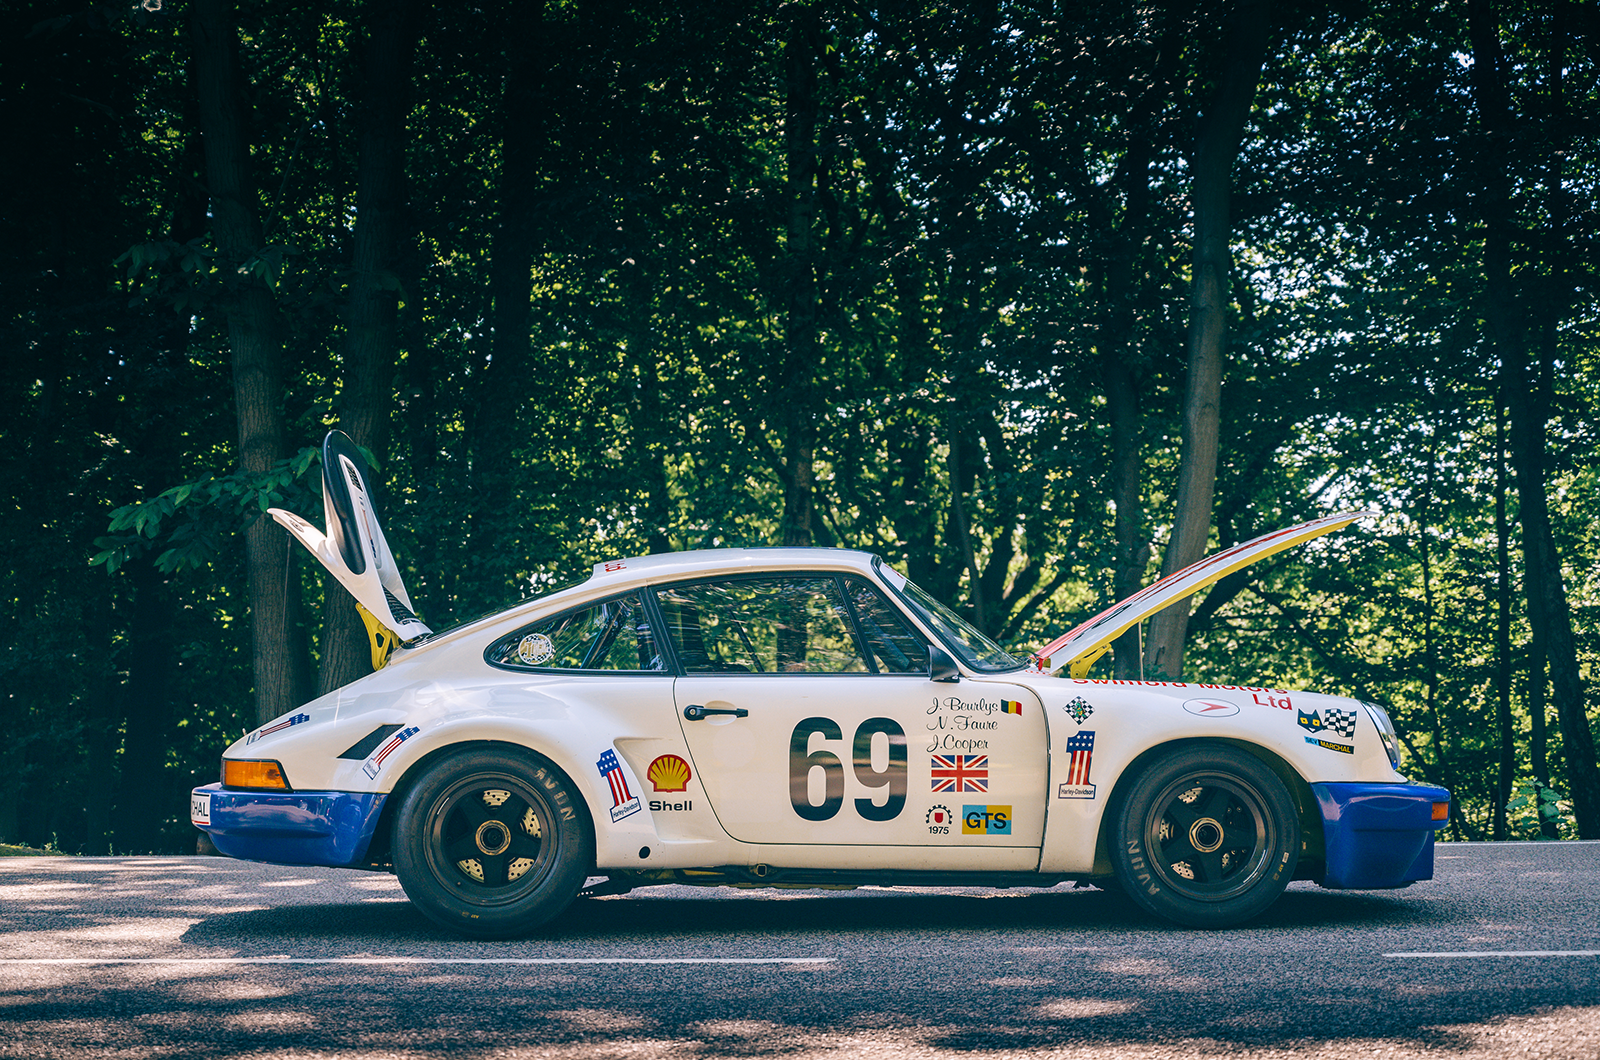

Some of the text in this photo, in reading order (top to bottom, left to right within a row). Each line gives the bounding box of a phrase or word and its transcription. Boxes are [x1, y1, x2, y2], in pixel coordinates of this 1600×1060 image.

[1252, 693, 1293, 711] Ltd
[1320, 741, 1351, 754] MARCHAL
[789, 716, 908, 822] 69
[1061, 788, 1094, 796] Harley-Davidson
[613, 802, 639, 818] Harley-Davidson
[649, 801, 692, 811] Shell
[966, 811, 1007, 829] GTS
[928, 826, 949, 835] 1975
